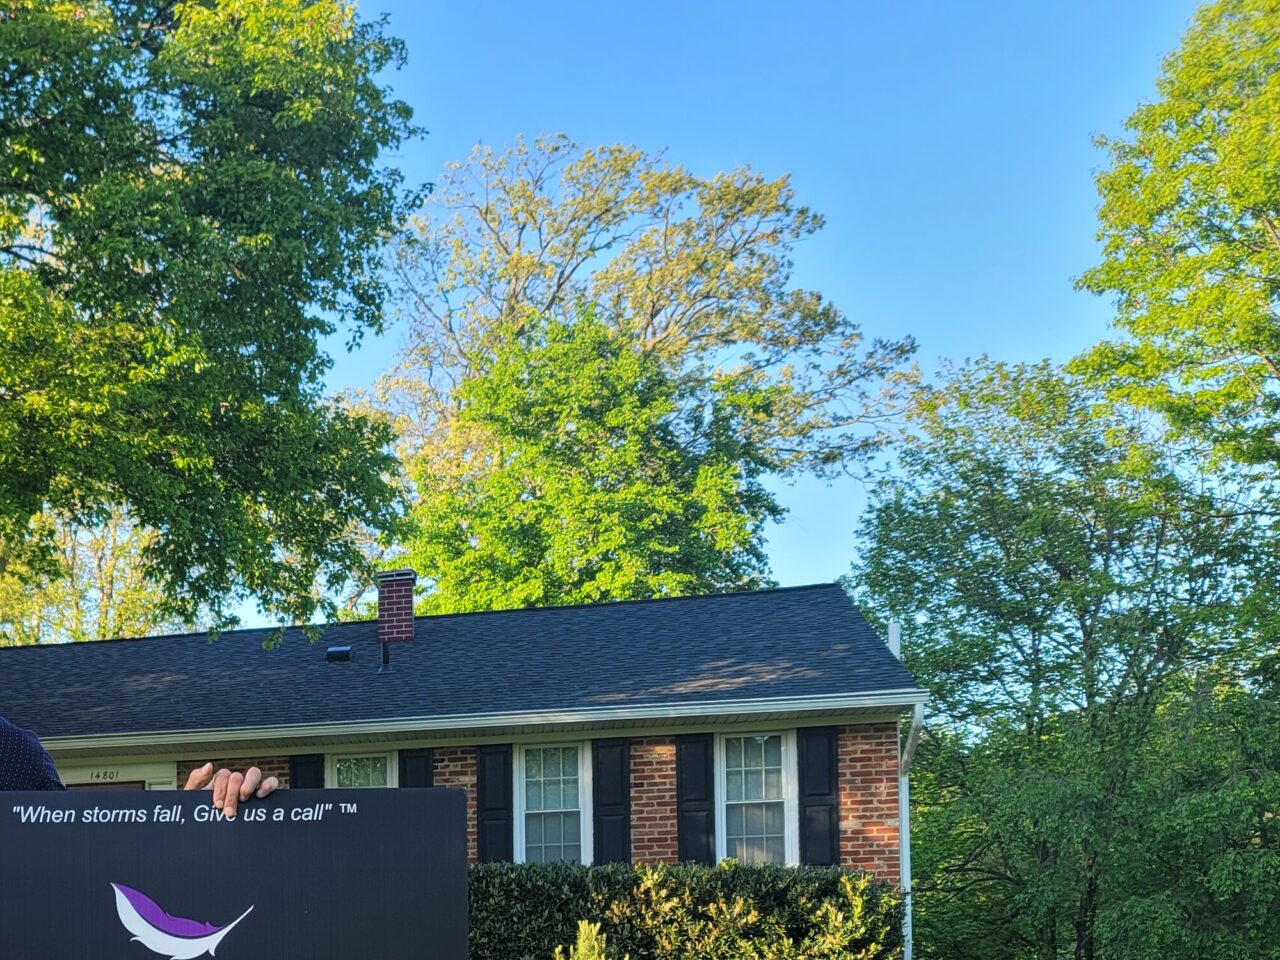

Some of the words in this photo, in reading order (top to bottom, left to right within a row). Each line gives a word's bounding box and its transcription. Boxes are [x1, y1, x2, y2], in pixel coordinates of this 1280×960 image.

[90, 770, 119, 780] 14801
[12, 805, 76, 823] "When
[81, 805, 147, 823] storms
[152, 804, 185, 825] fall,
[243, 807, 267, 821] us
[272, 807, 285, 821] a
[290, 803, 333, 821] call"
